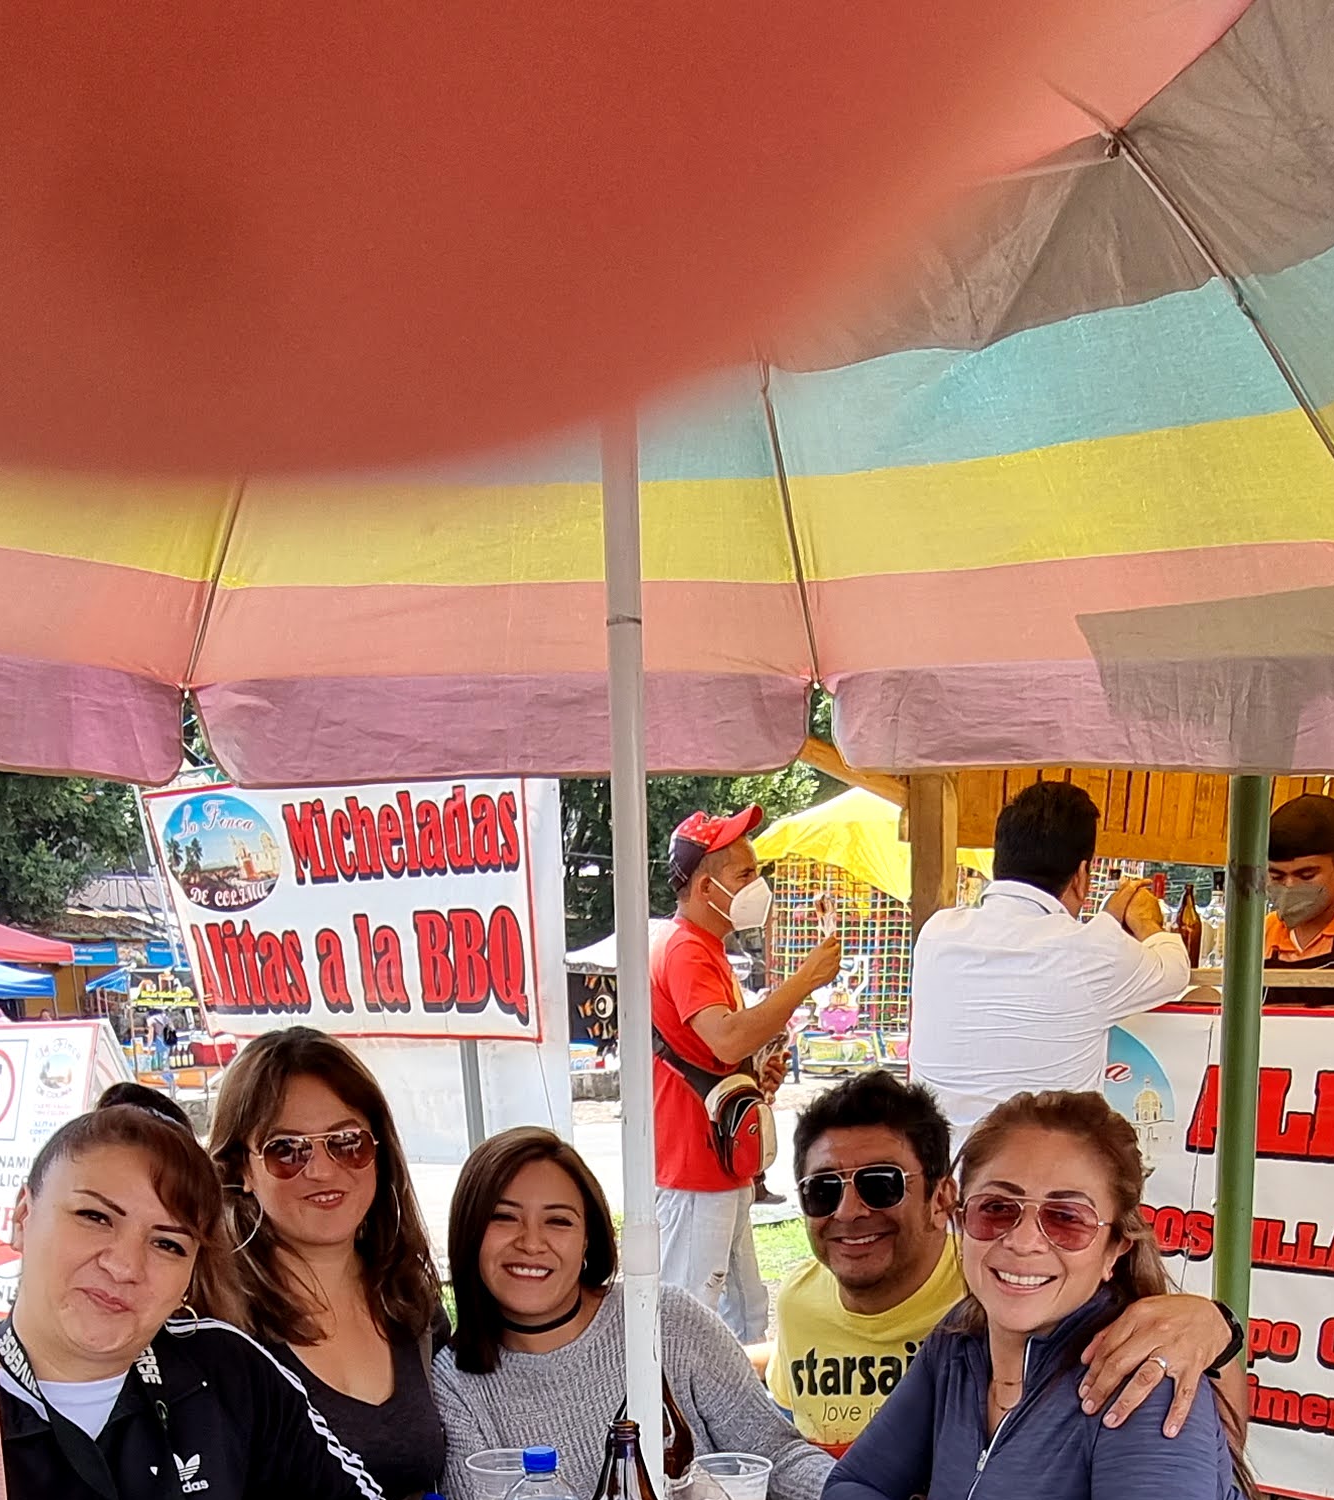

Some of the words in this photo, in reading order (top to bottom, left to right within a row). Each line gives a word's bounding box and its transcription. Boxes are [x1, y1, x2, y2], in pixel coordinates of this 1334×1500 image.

[203, 799, 255, 832] Finca
[282, 784, 521, 886] Micheladas
[190, 886, 210, 906] DE
[214, 881, 268, 907] COLIMA
[191, 919, 312, 1015] Alitas
[314, 927, 355, 1014] a
[354, 912, 411, 1014] la
[412, 904, 530, 1027] BBQ
[1247, 1317, 1301, 1370] po
[821, 1401, 862, 1422] love
[181, 1480, 210, 1494] das
